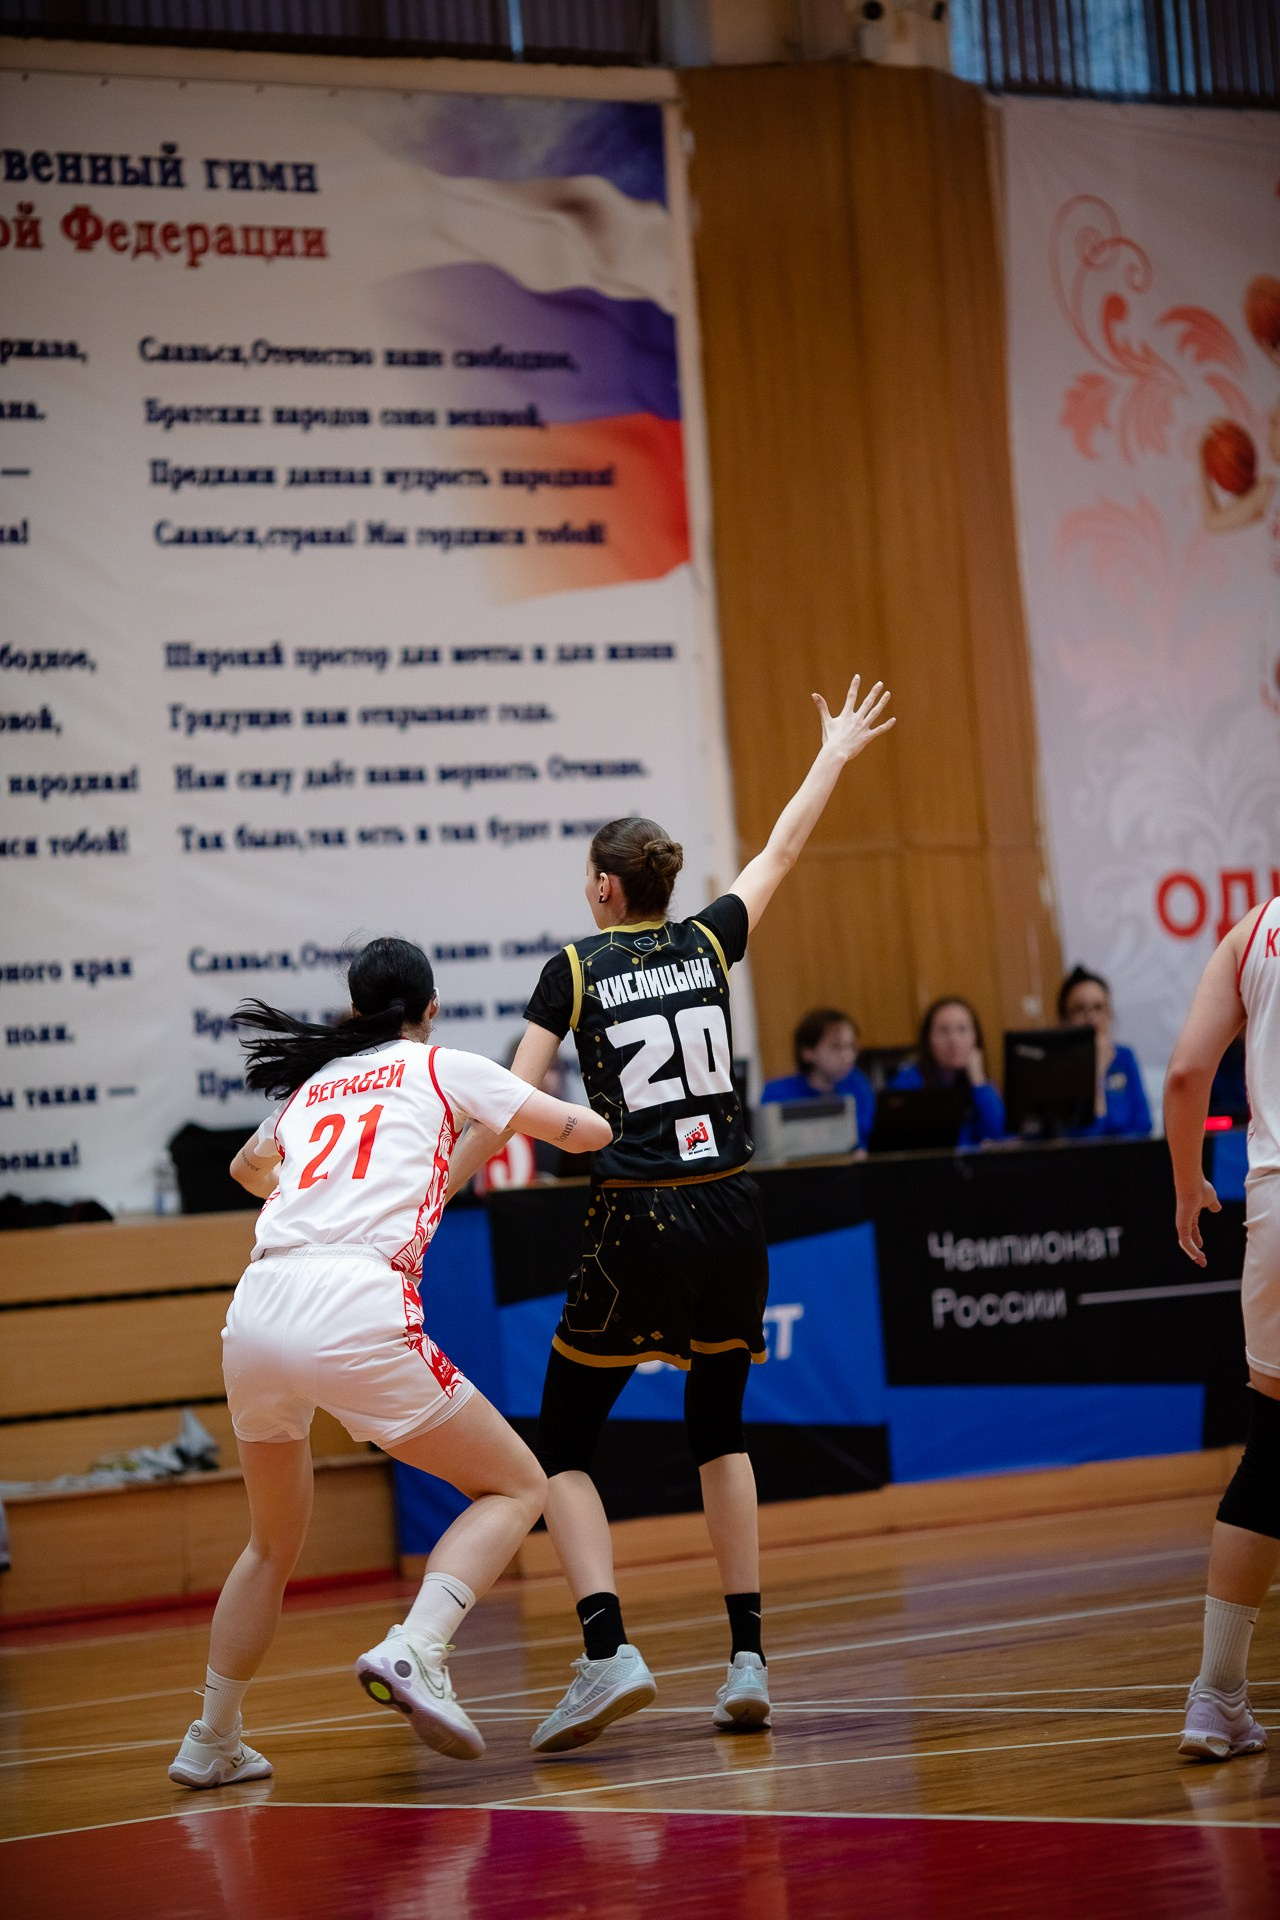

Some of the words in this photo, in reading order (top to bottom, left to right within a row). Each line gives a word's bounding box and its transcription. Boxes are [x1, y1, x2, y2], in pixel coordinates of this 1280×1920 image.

[202, 158, 319, 194] гимн
[58, 203, 328, 269] Федерации
[1155, 867, 1280, 945] ОД
[0, 963, 63, 983] ного
[596, 957, 716, 1009] КИСЛИЦЫНА
[306, 1060, 405, 1107] ВЕРАБЕЙ
[604, 1005, 734, 1113] 20
[298, 1104, 384, 1189] 21
[927, 1225, 1123, 1274] Чемпионат
[930, 1287, 1069, 1331] России
